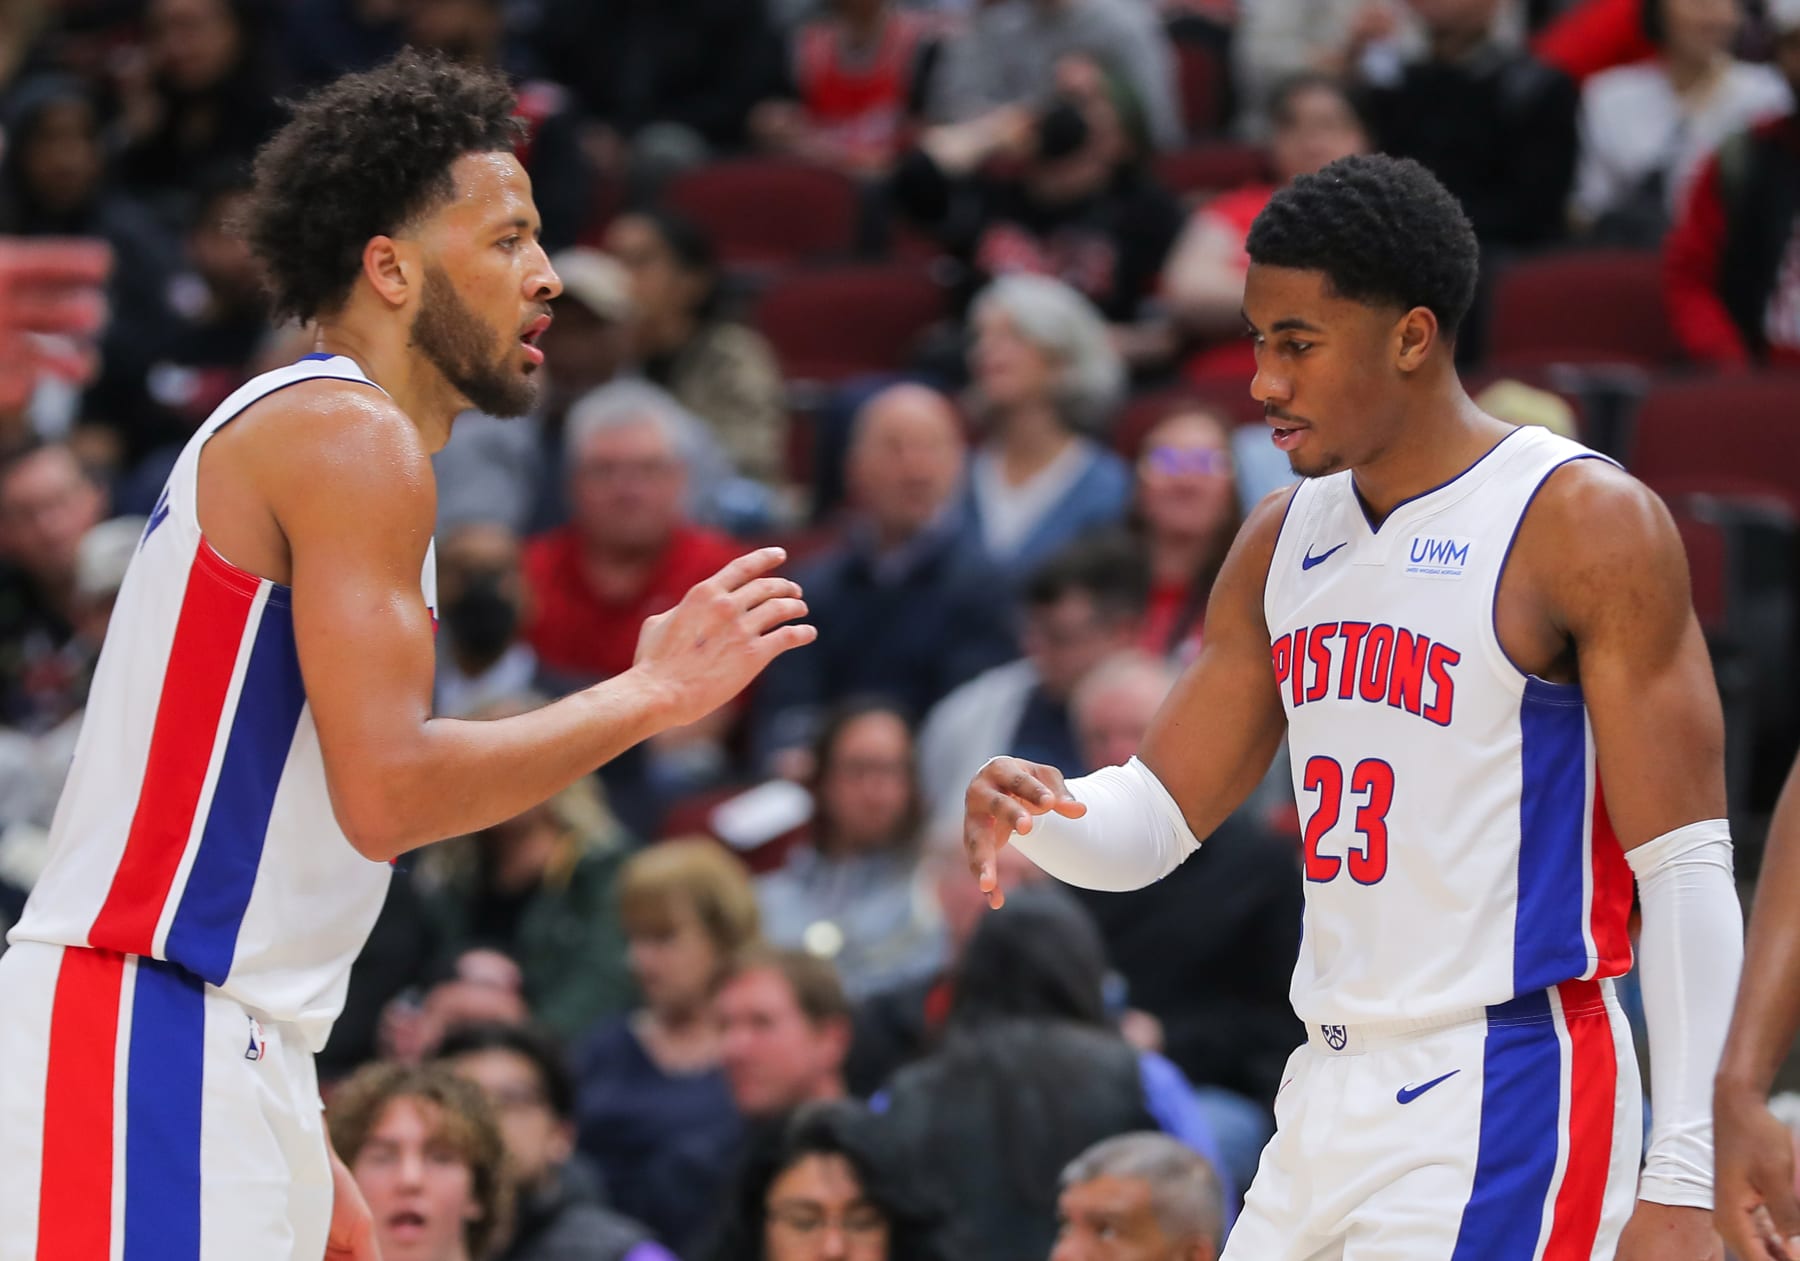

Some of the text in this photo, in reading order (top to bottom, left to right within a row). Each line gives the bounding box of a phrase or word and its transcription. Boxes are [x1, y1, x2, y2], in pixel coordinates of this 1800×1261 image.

[1410, 537, 1470, 566] UWM
[1271, 621, 1461, 727] PISTONS
[1303, 755, 1395, 886] 23
